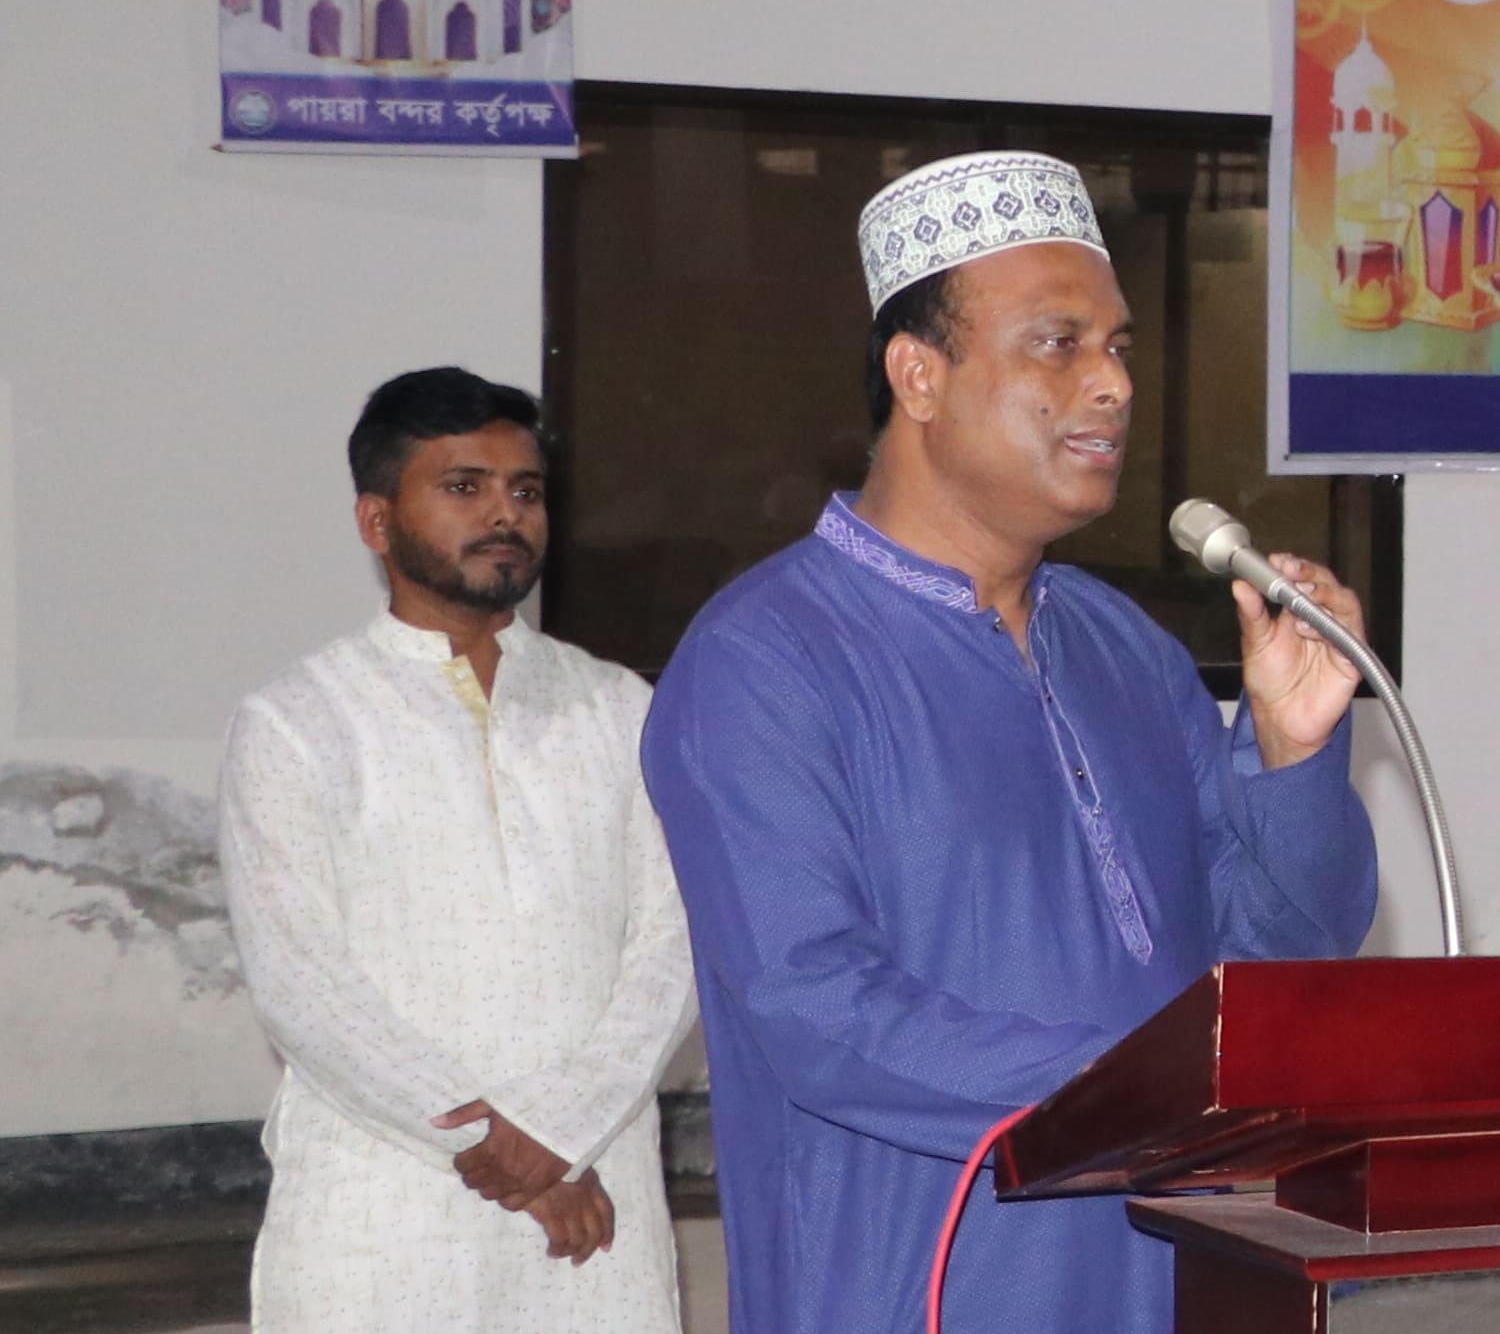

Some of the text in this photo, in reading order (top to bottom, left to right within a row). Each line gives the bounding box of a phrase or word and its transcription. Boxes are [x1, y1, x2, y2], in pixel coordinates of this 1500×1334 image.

[287, 90, 553, 136] পায়রা বন্দর কর্তৃপক্ষ
